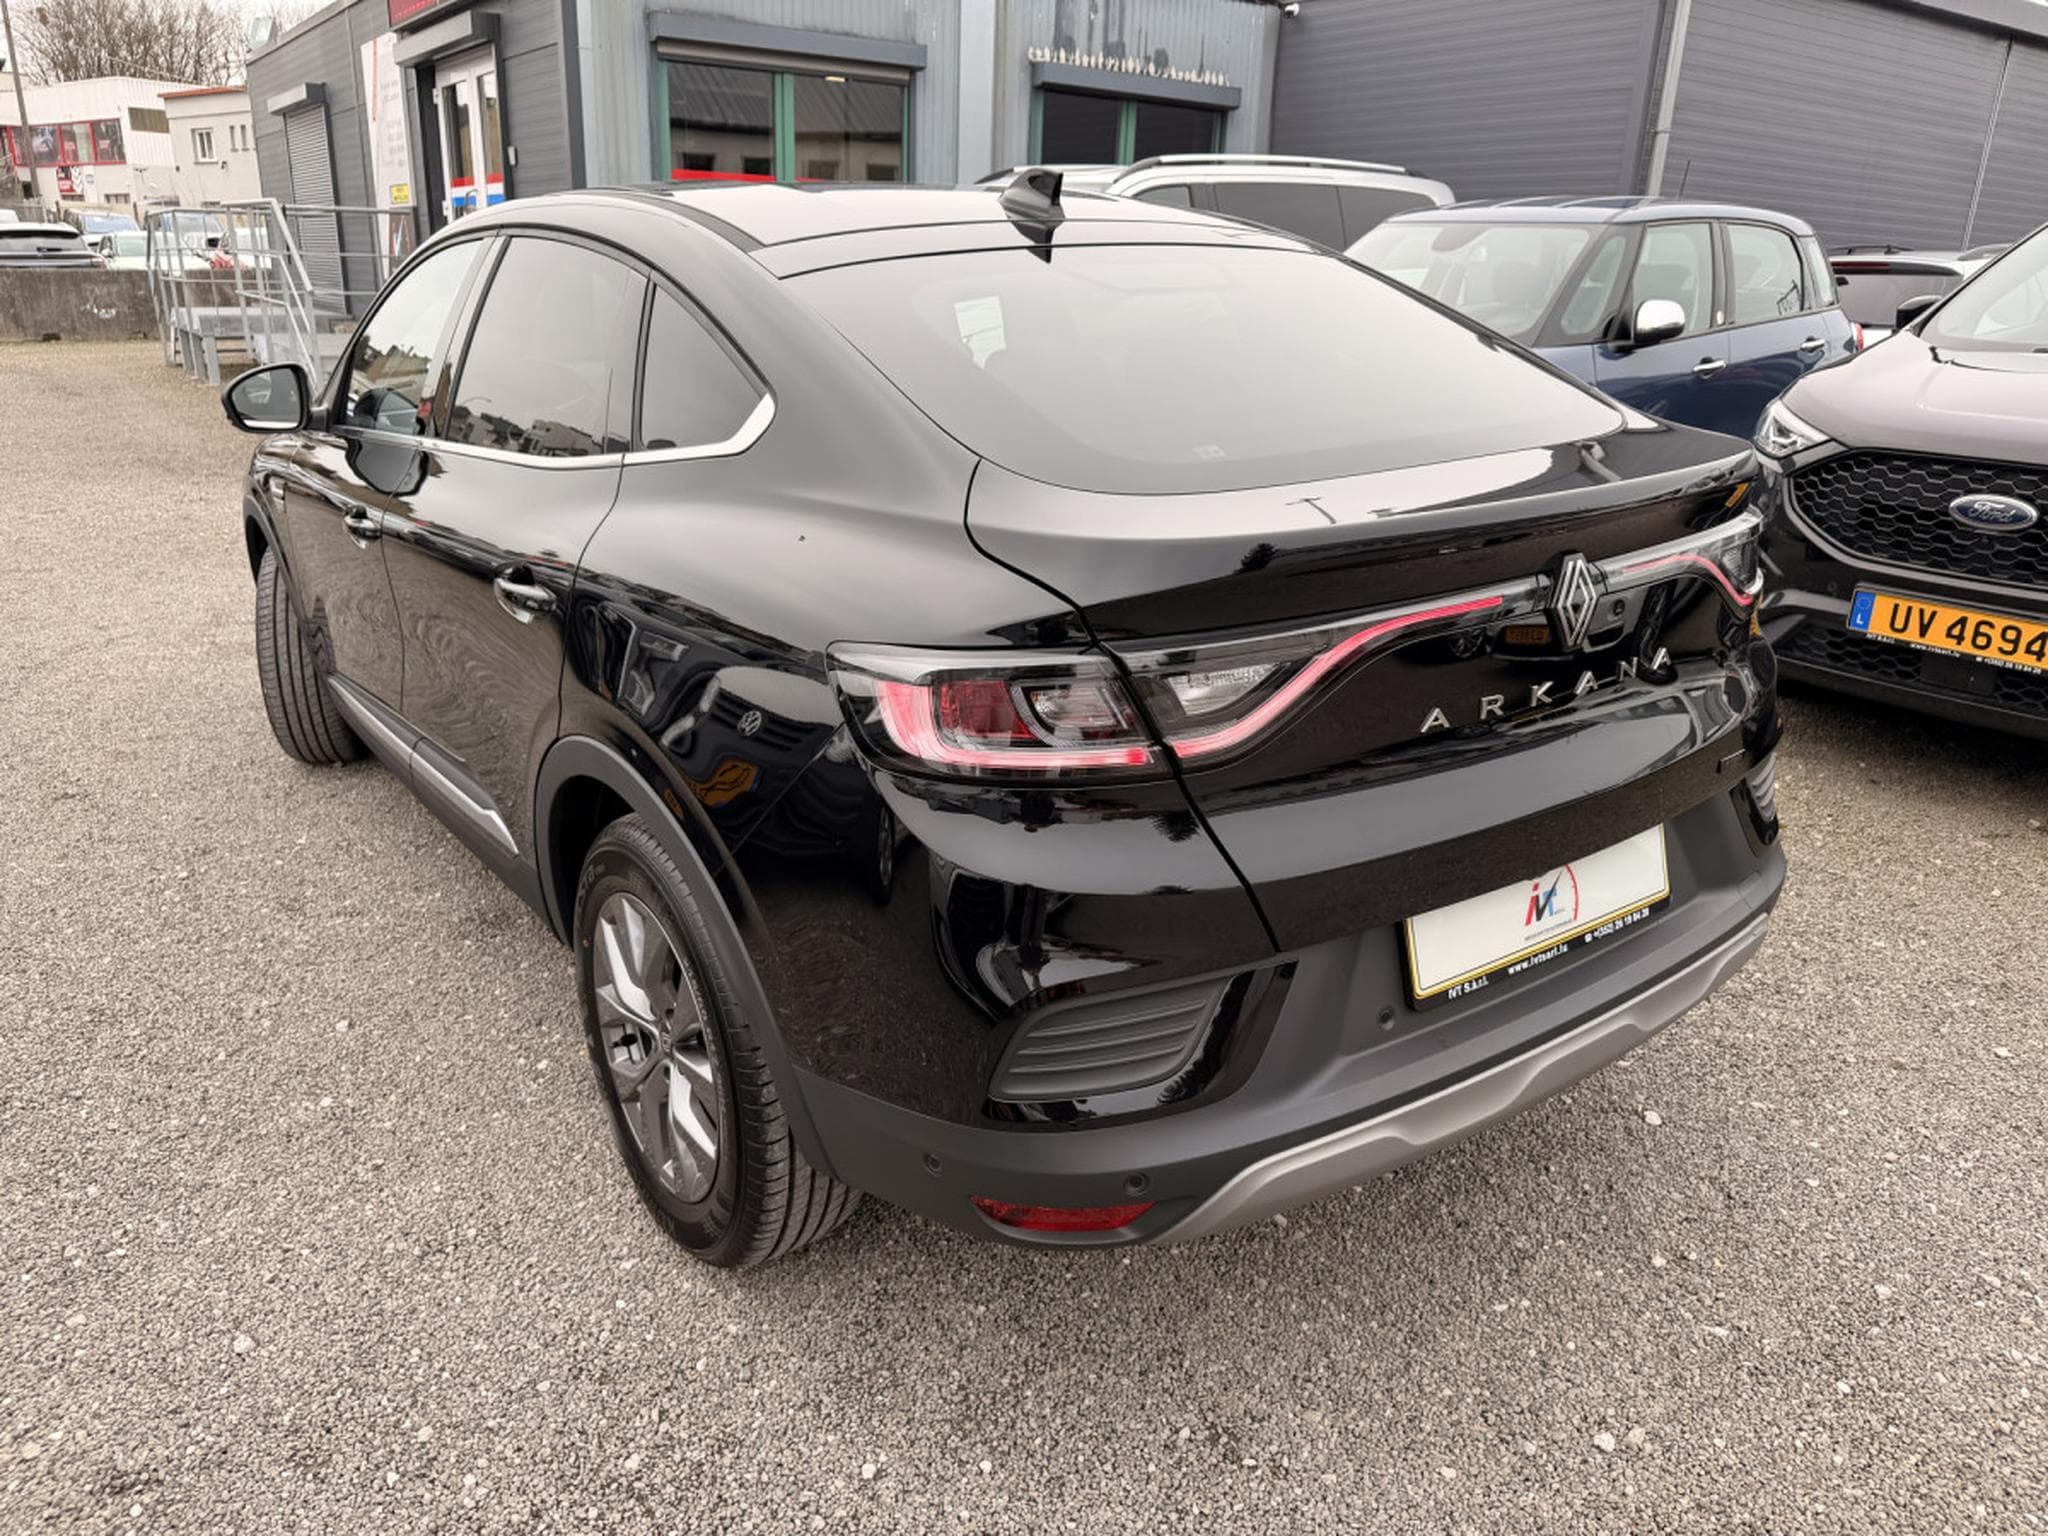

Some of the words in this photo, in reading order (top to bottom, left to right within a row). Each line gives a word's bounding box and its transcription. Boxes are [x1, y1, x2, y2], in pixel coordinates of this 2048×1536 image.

[1855, 613, 1864, 625] L
[1889, 603, 1938, 639] UV
[1945, 616, 2048, 662] 4694
[1419, 646, 1673, 734] ARKANA
